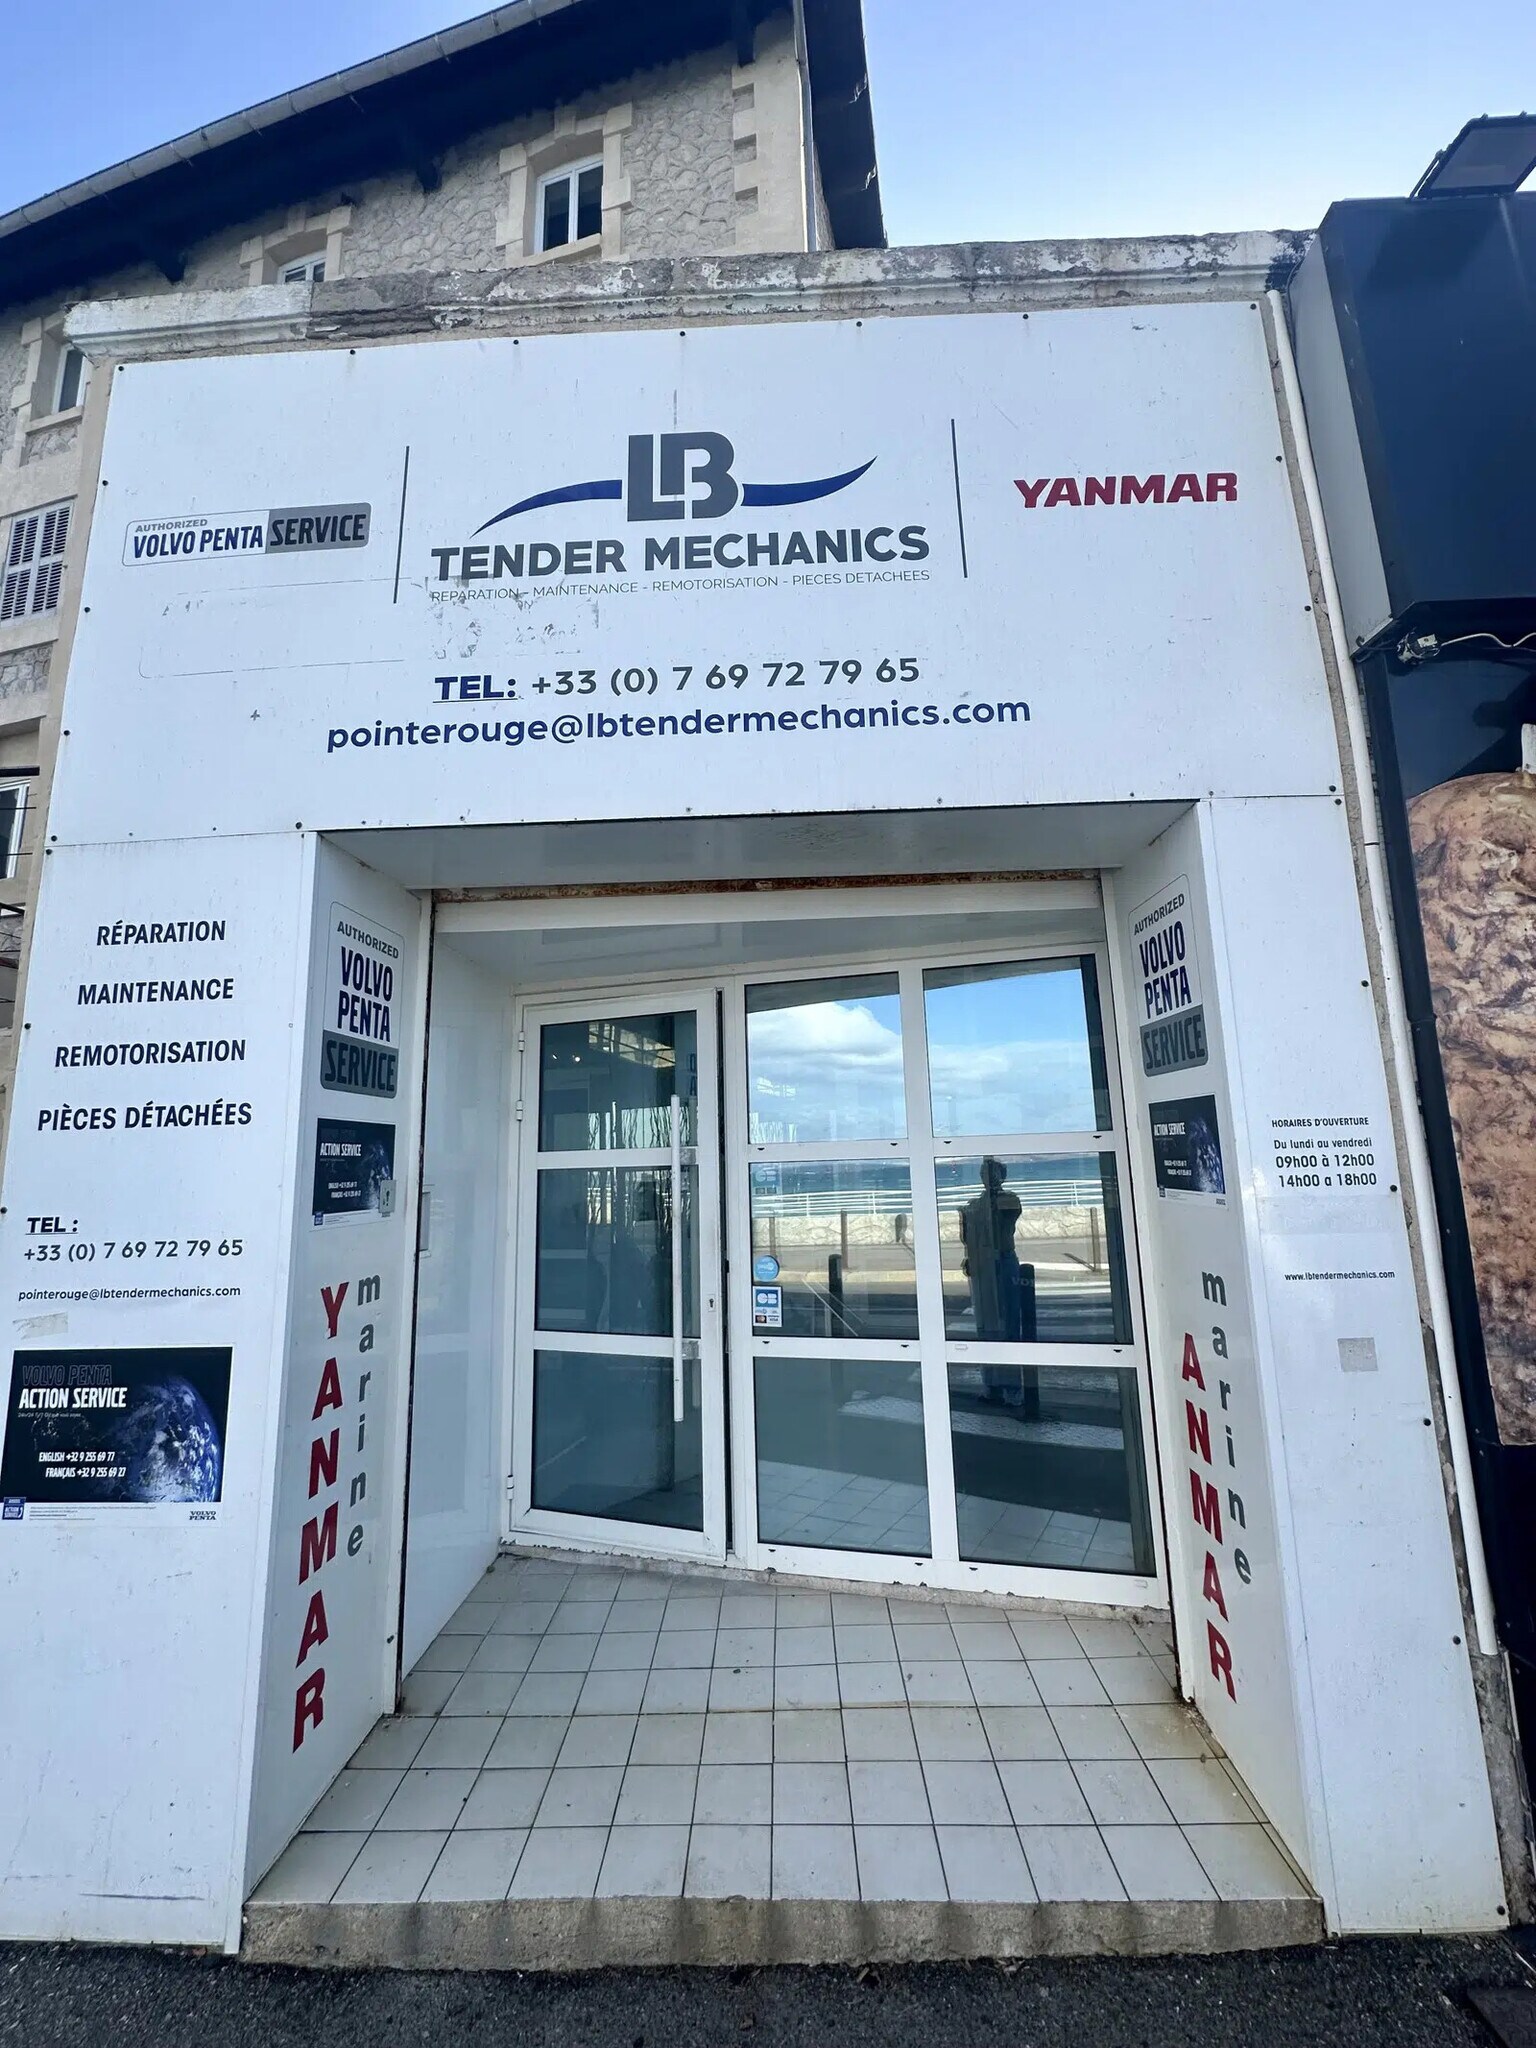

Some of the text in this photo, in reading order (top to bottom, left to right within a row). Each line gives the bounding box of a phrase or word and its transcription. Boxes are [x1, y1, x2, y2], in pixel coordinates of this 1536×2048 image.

[1013, 472, 1238, 508] YANMAR
[134, 513, 367, 559] VOLVO PENTA SERVICE
[135, 519, 208, 533] AUTHORIZED
[431, 525, 930, 581] TENDER MECHANICS
[432, 587, 519, 602] REPARATION
[533, 582, 638, 598] MAINTENANCE
[652, 576, 778, 592] REMOTORISATION
[793, 573, 842, 586] PIECES
[846, 570, 930, 584] DETACHEES
[434, 657, 920, 701] TEL: +33 (0) 7 69 72 79 65
[327, 699, 1031, 753] pointerouge@lbtendermechanics.com
[1133, 893, 1186, 937] AUTHORIZED
[97, 919, 227, 947] RÉPARATION
[337, 920, 400, 960] AUTHORIZED
[1139, 920, 1187, 978] VOLVO
[341, 945, 393, 1001] VOLVO
[77, 978, 234, 1005] MAINTENANCE
[1144, 965, 1192, 1020] PENTA
[337, 990, 391, 1042] PENTA
[54, 1039, 246, 1068] REMOTORISATION
[1143, 1014, 1207, 1070] SERVICE
[324, 1043, 396, 1093] SERVICE
[37, 1098, 253, 1131] PIÈCES DÉTACHÉES
[1272, 1117, 1369, 1128] HORAIRES D'OUVERTURE
[320, 1143, 362, 1156] ACTION SERVICE
[1274, 1137, 1372, 1149] Du lundi au vendredi
[1276, 1153, 1375, 1168] 09h00 à 12h00
[1279, 1174, 1320, 1187] 14h00
[1337, 1173, 1377, 1186] 18h00
[24, 1239, 244, 1263] +33 (0) 7 69 72 79 65
[1285, 1271, 1395, 1281] www.lbtendermechanics.com
[18, 1285, 241, 1302] pointerouge@lbtendermechanics.com
[22, 1364, 112, 1386] VOLVO PENTA
[19, 1387, 128, 1409] ACTION SERVICE
[347, 1274, 381, 1557] marine
[1202, 1271, 1252, 1585] marine
[39, 1451, 65, 1462] ENGLISH
[66, 1452, 78, 1462] +32
[79, 1452, 85, 1462] 9
[85, 1452, 96, 1462] 255
[45, 1467, 76, 1479] FRANÇAIS
[77, 1467, 90, 1478] +32
[90, 1467, 96, 1478] 9
[96, 1467, 108, 1478] 255
[292, 1281, 349, 1754] YANMAR
